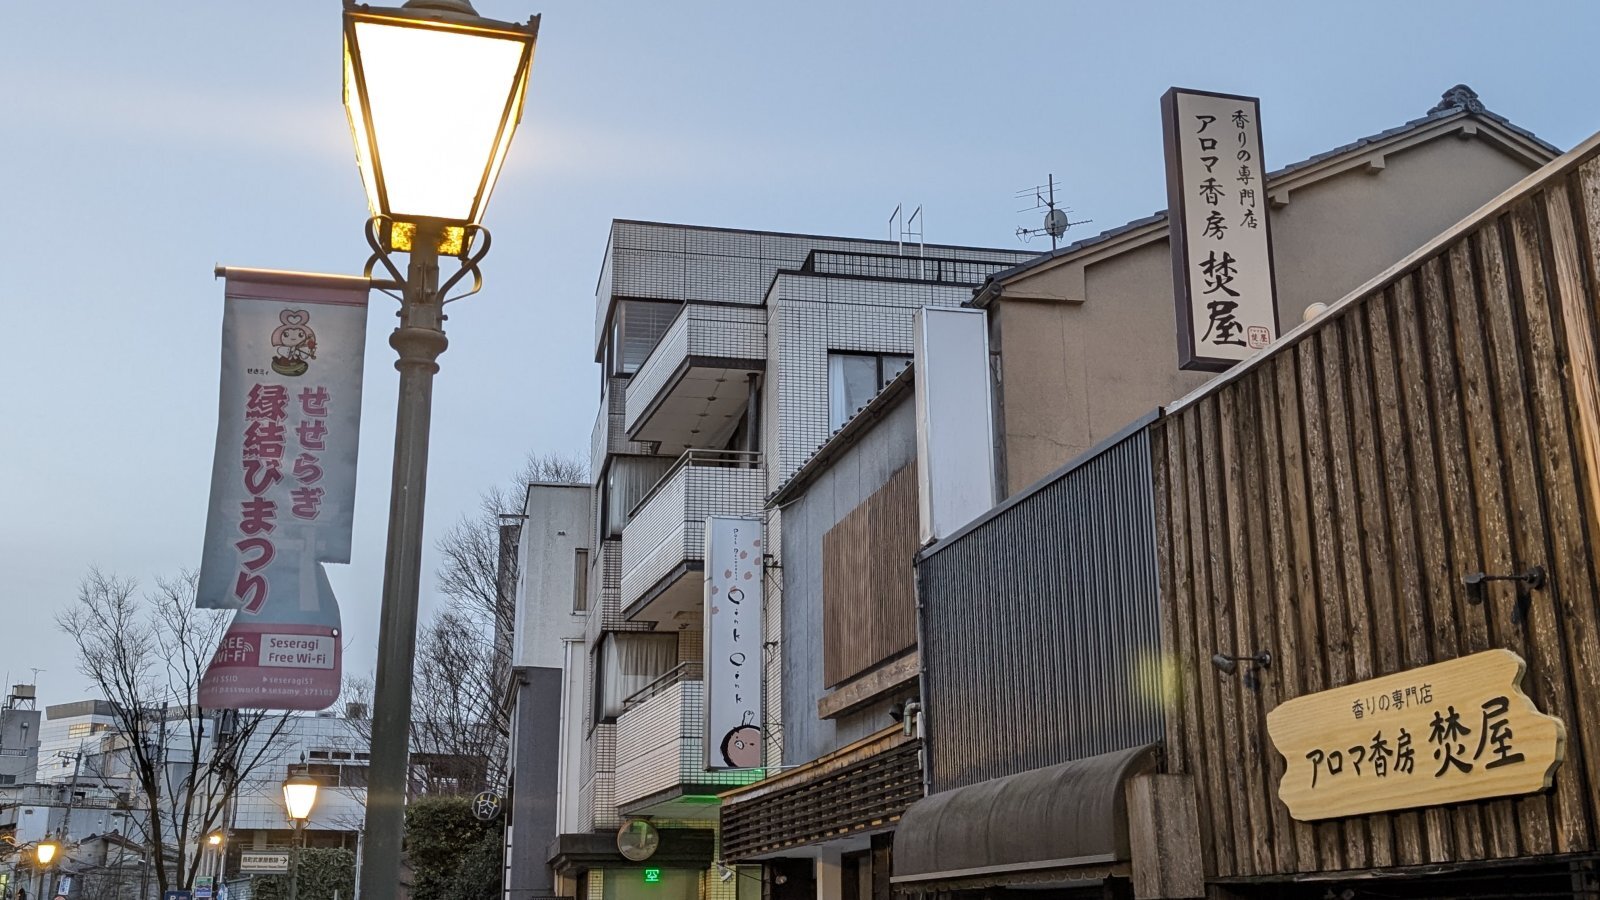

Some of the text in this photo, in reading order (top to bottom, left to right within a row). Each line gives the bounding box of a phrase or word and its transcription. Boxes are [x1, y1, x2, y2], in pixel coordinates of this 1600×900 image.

[1231, 109, 1258, 229] 香りの専門店
[1195, 114, 1247, 348] アロマ香房 焚屋
[290, 386, 330, 521] せせらぎ
[234, 383, 289, 614] 縁結びまつり
[220, 637, 244, 649] REE
[269, 653, 326, 665] Free Wi-Fi
[270, 637, 319, 651] Seseragi
[727, 587, 746, 704] Oink Oink
[219, 686, 260, 695] password
[220, 675, 238, 683] SSID
[1352, 682, 1433, 720] 香りの専門店
[1305, 695, 1526, 789] アロマ香房 焚屋
[645, 869, 660, 882] 空
